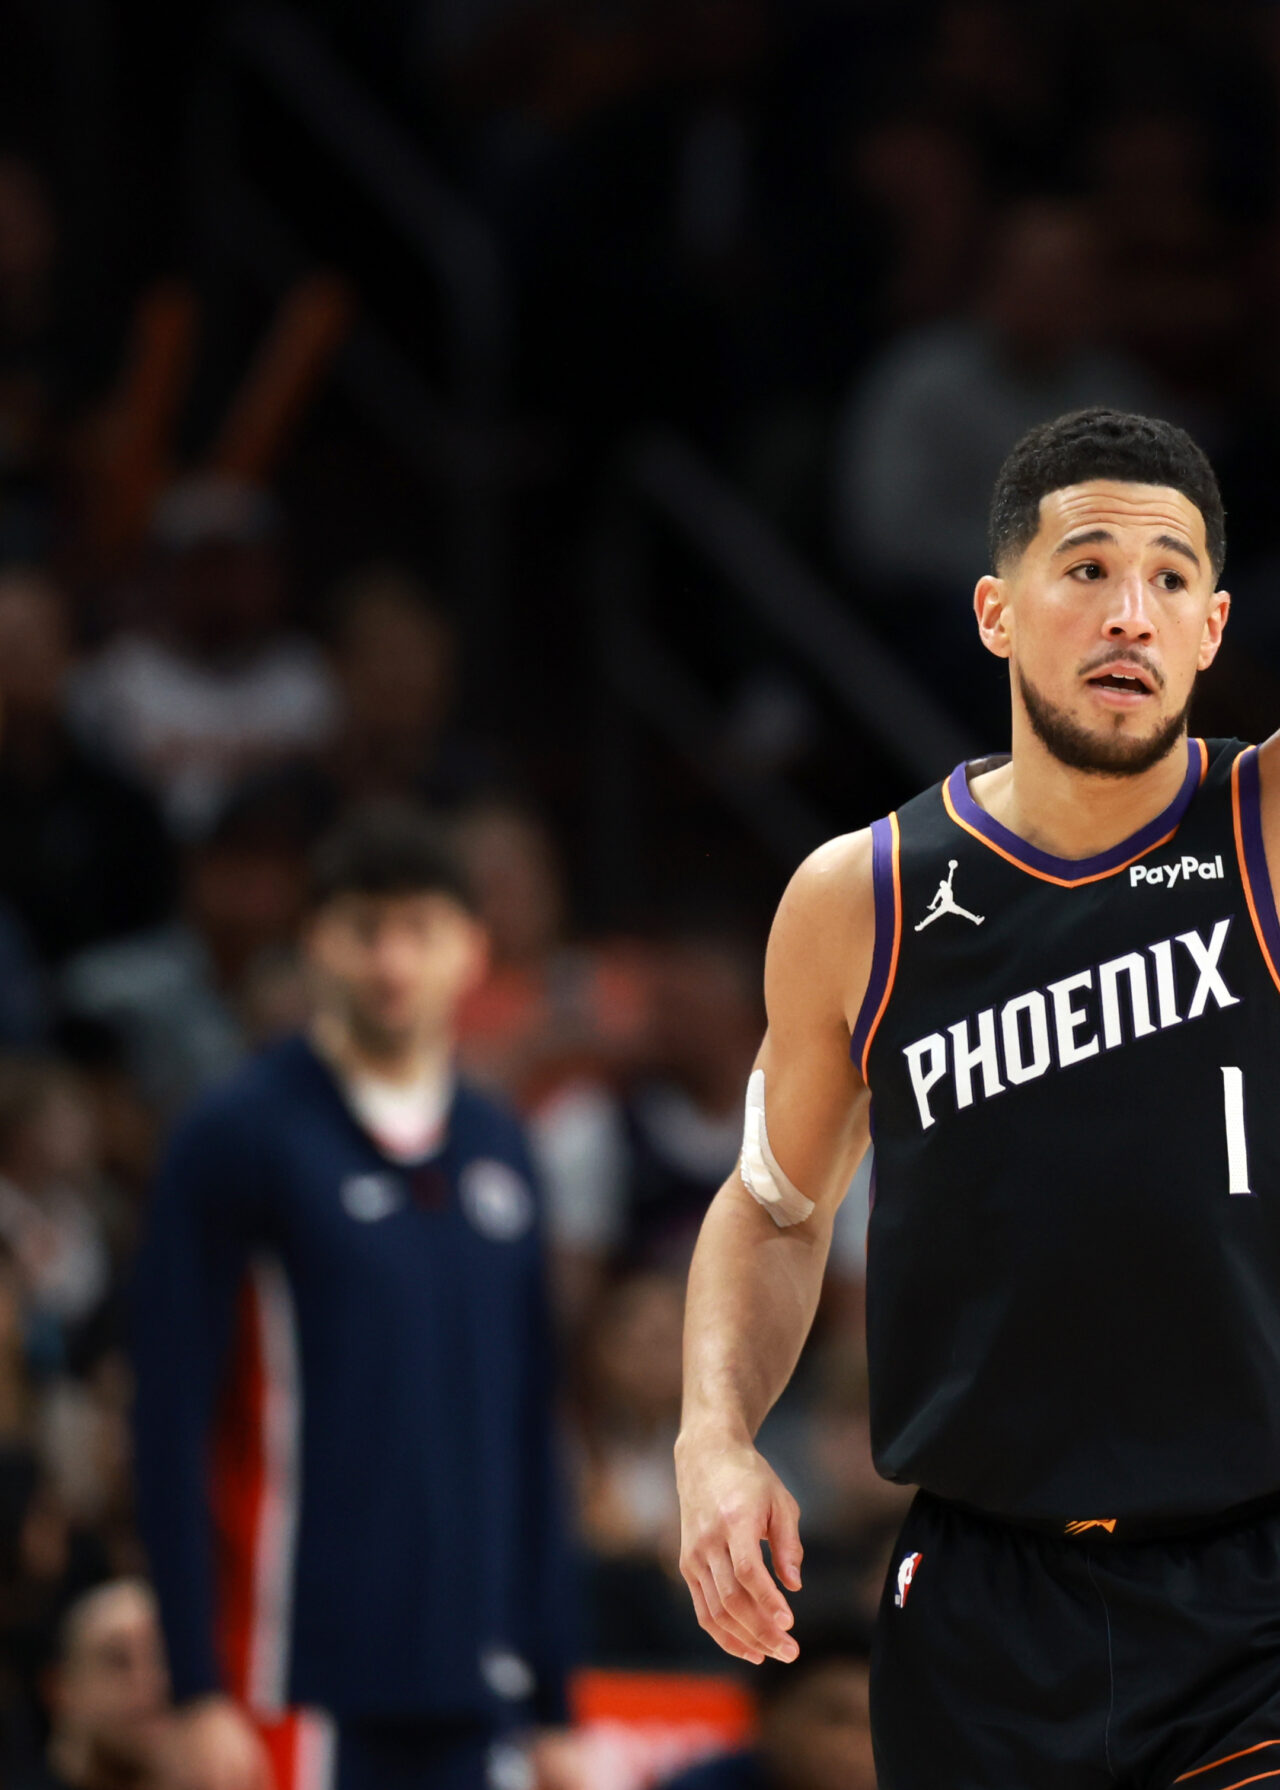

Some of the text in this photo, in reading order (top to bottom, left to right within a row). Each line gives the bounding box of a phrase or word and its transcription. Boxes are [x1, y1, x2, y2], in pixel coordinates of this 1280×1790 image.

[1129, 855, 1225, 889] PayPal
[902, 917, 1241, 1132] PHOENIX
[1219, 1066, 1252, 1195] 1
